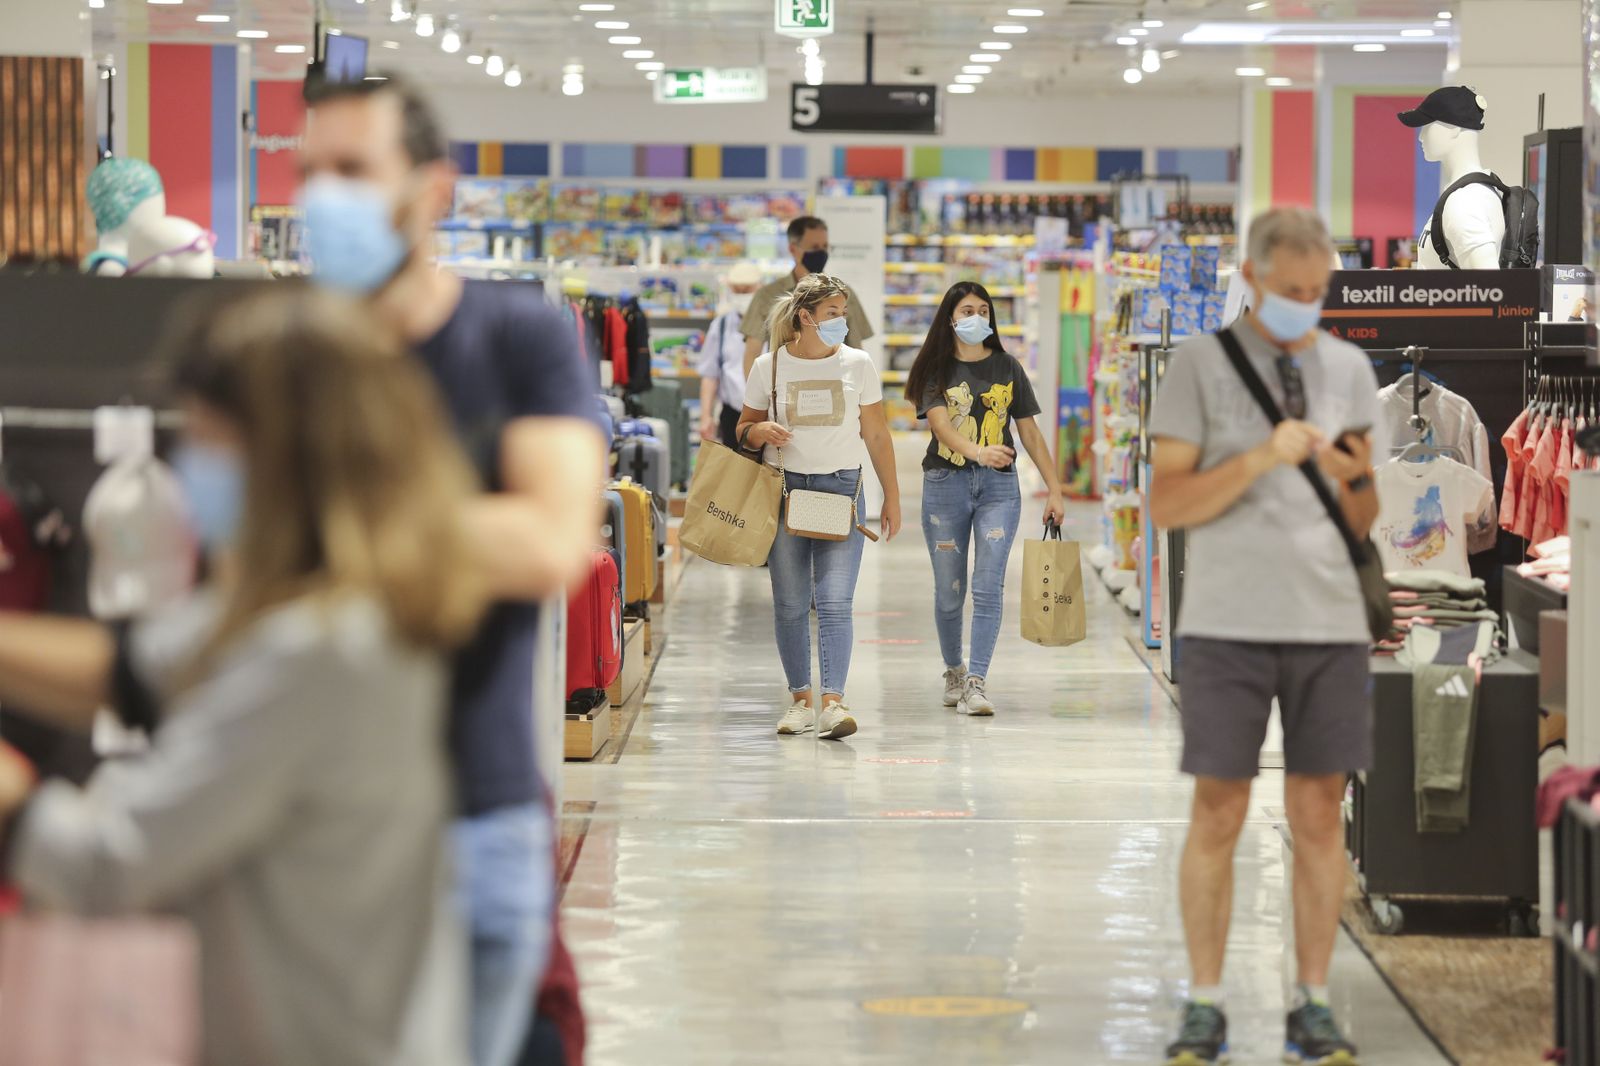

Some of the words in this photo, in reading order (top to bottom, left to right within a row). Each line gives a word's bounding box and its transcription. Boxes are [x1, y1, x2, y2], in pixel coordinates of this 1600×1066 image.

[793, 87, 820, 126] 5
[1342, 285, 1395, 303] textil
[1399, 284, 1504, 306] deportivo
[1498, 304, 1535, 319] júnior
[1347, 327, 1378, 339] KIDS
[706, 500, 746, 529] Bershka
